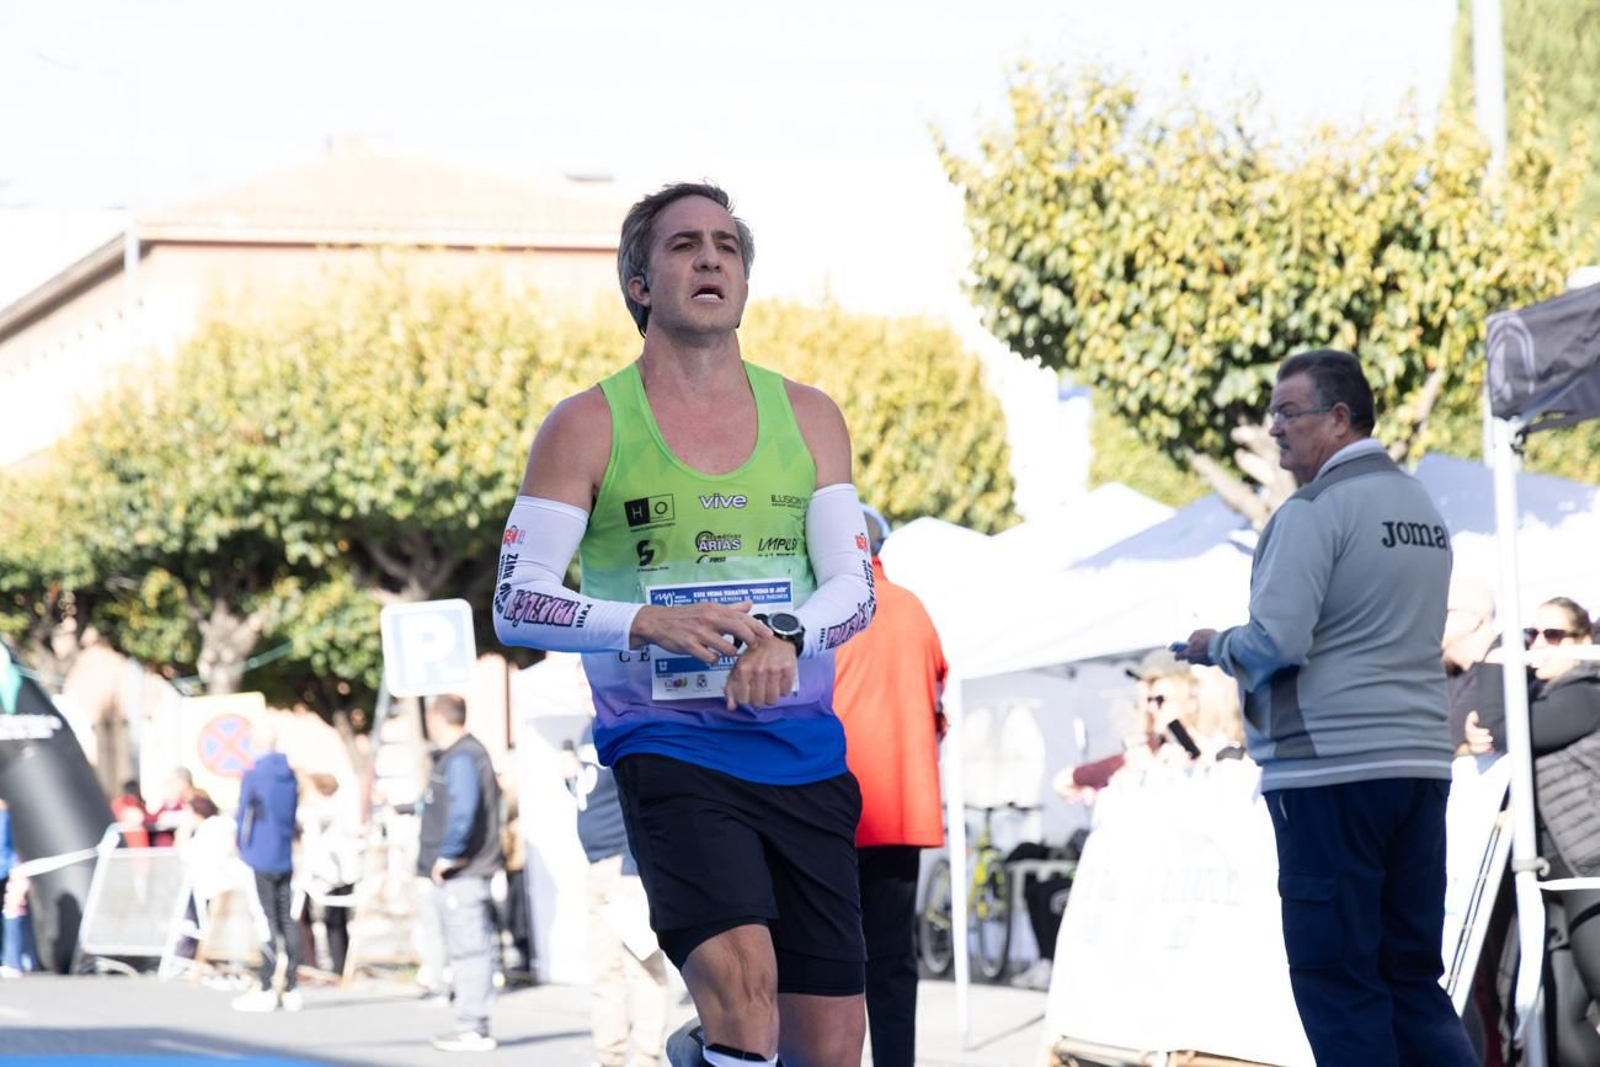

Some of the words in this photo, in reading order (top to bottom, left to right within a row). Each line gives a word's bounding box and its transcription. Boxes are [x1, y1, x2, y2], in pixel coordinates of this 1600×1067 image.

[698, 492, 748, 509] vive
[698, 538, 742, 551] ARIAS
[1381, 521, 1448, 551] Joma
[400, 613, 455, 685] P
